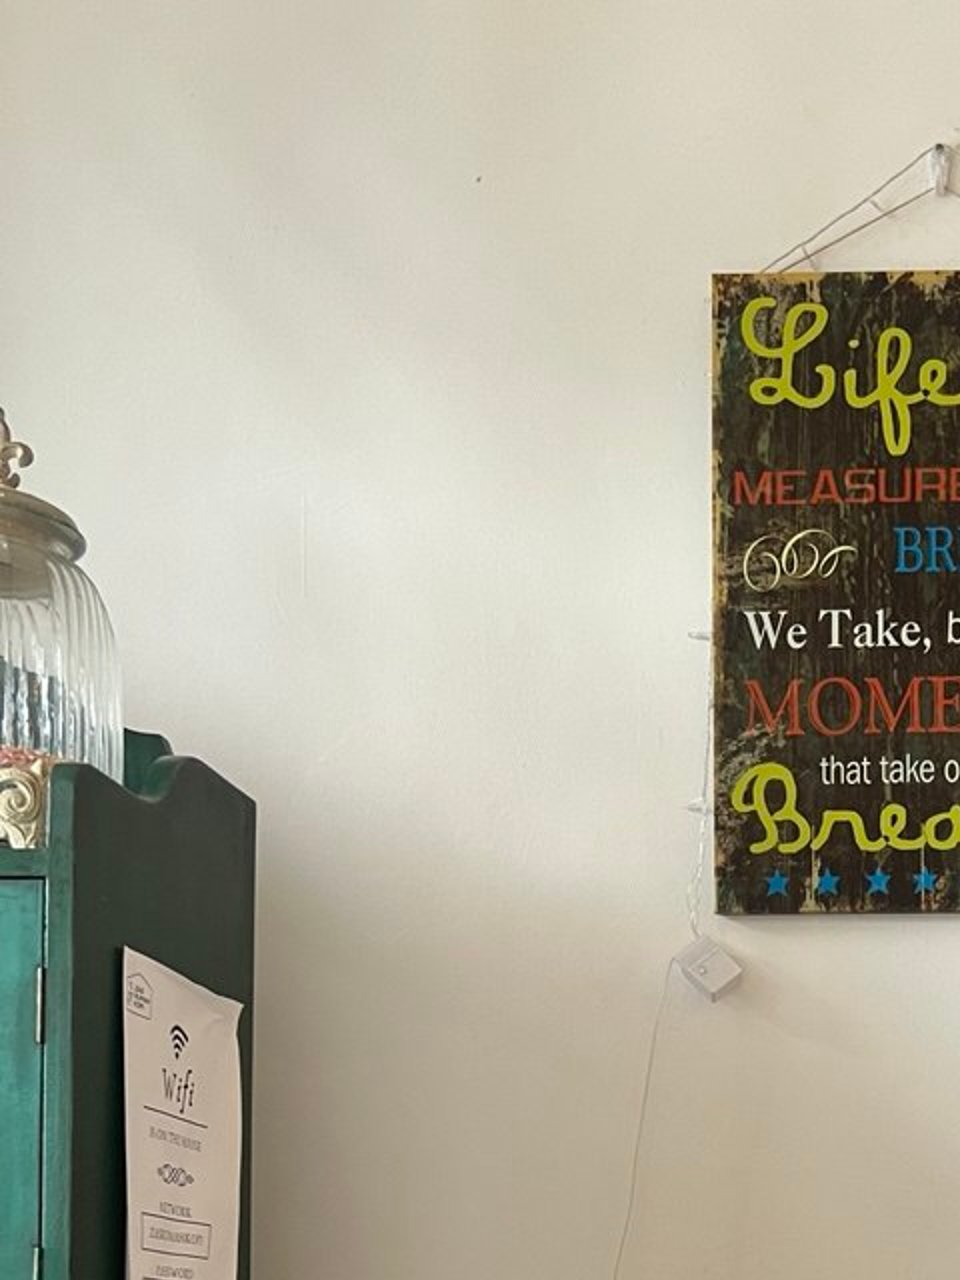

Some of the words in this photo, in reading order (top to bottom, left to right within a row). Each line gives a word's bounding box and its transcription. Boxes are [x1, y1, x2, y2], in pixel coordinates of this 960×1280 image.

[744, 611, 807, 650] We
[819, 609, 932, 653] Take,
[820, 755, 871, 785] that
[880, 754, 935, 784] take
[161, 1067, 195, 1114] Wifi
